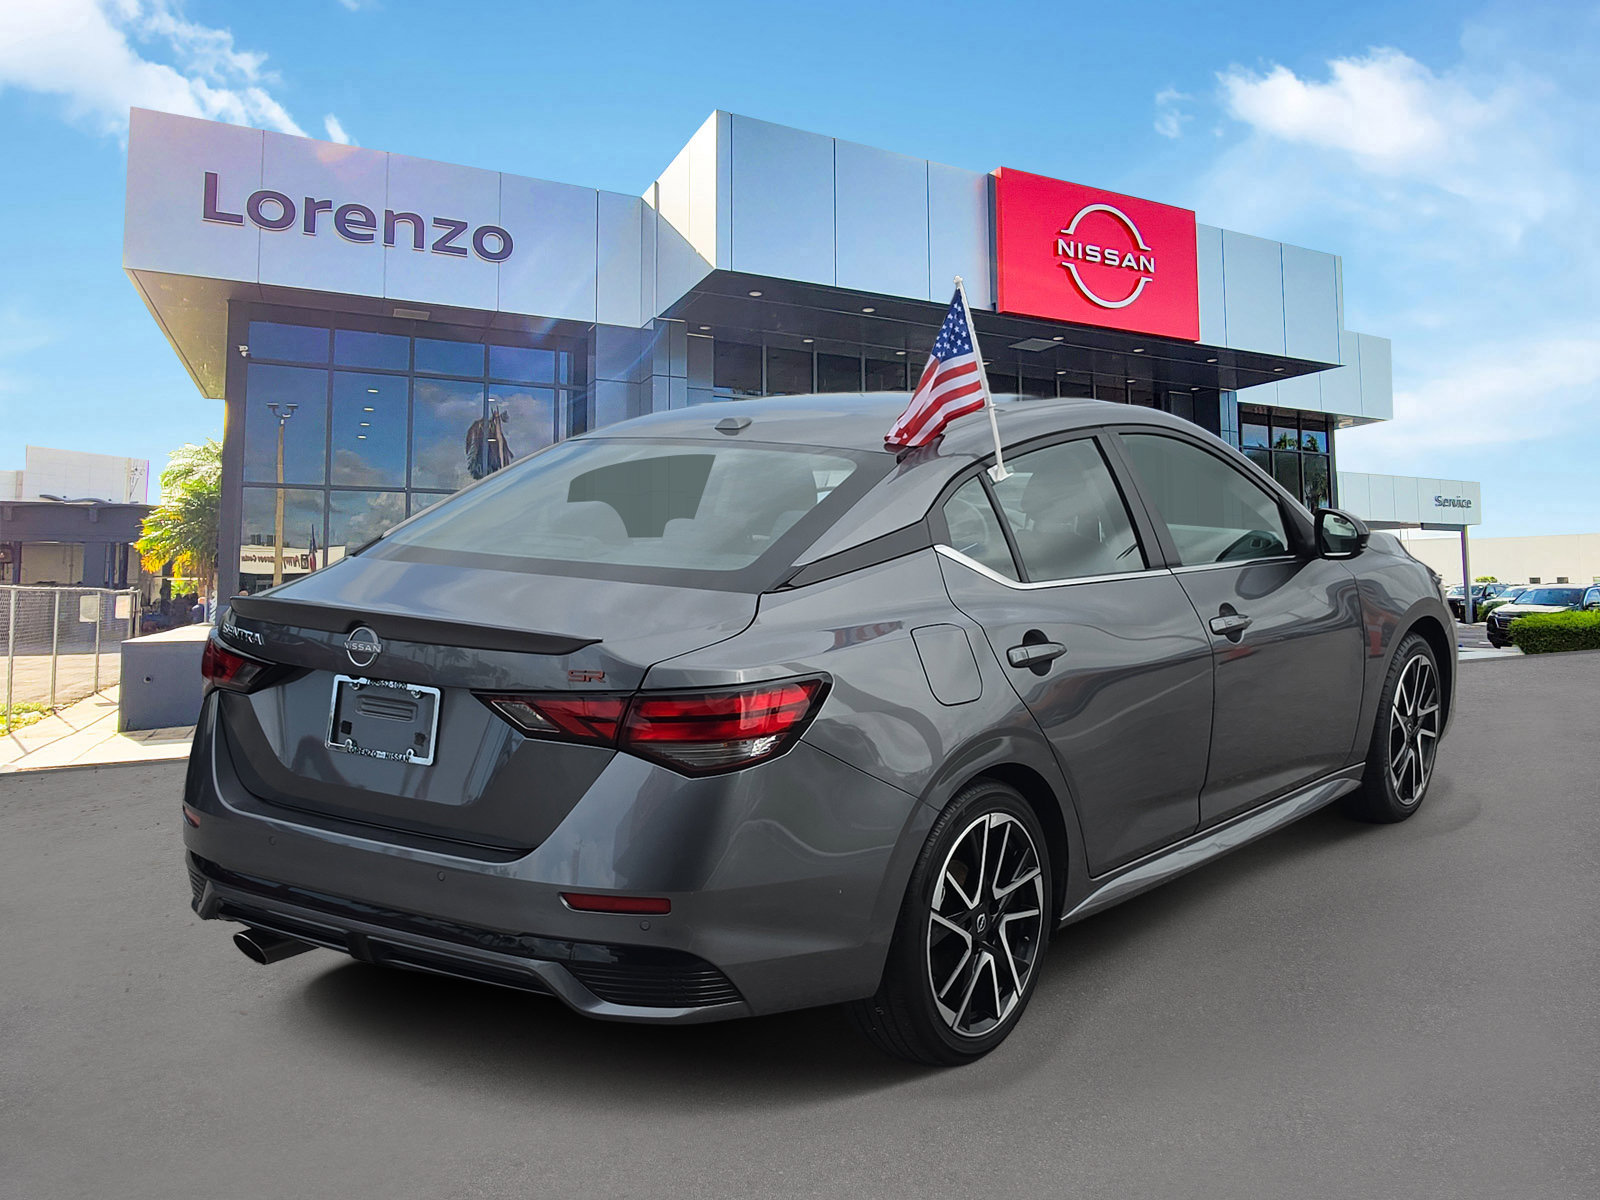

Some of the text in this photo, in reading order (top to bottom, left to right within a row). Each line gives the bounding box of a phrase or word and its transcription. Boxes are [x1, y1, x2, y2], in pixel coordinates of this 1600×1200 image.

[202, 171, 514, 262] Lorenzo
[1057, 238, 1155, 273] NISSAN
[1434, 495, 1472, 508] Service
[344, 640, 382, 653] NISSAN
[568, 669, 605, 683] SR
